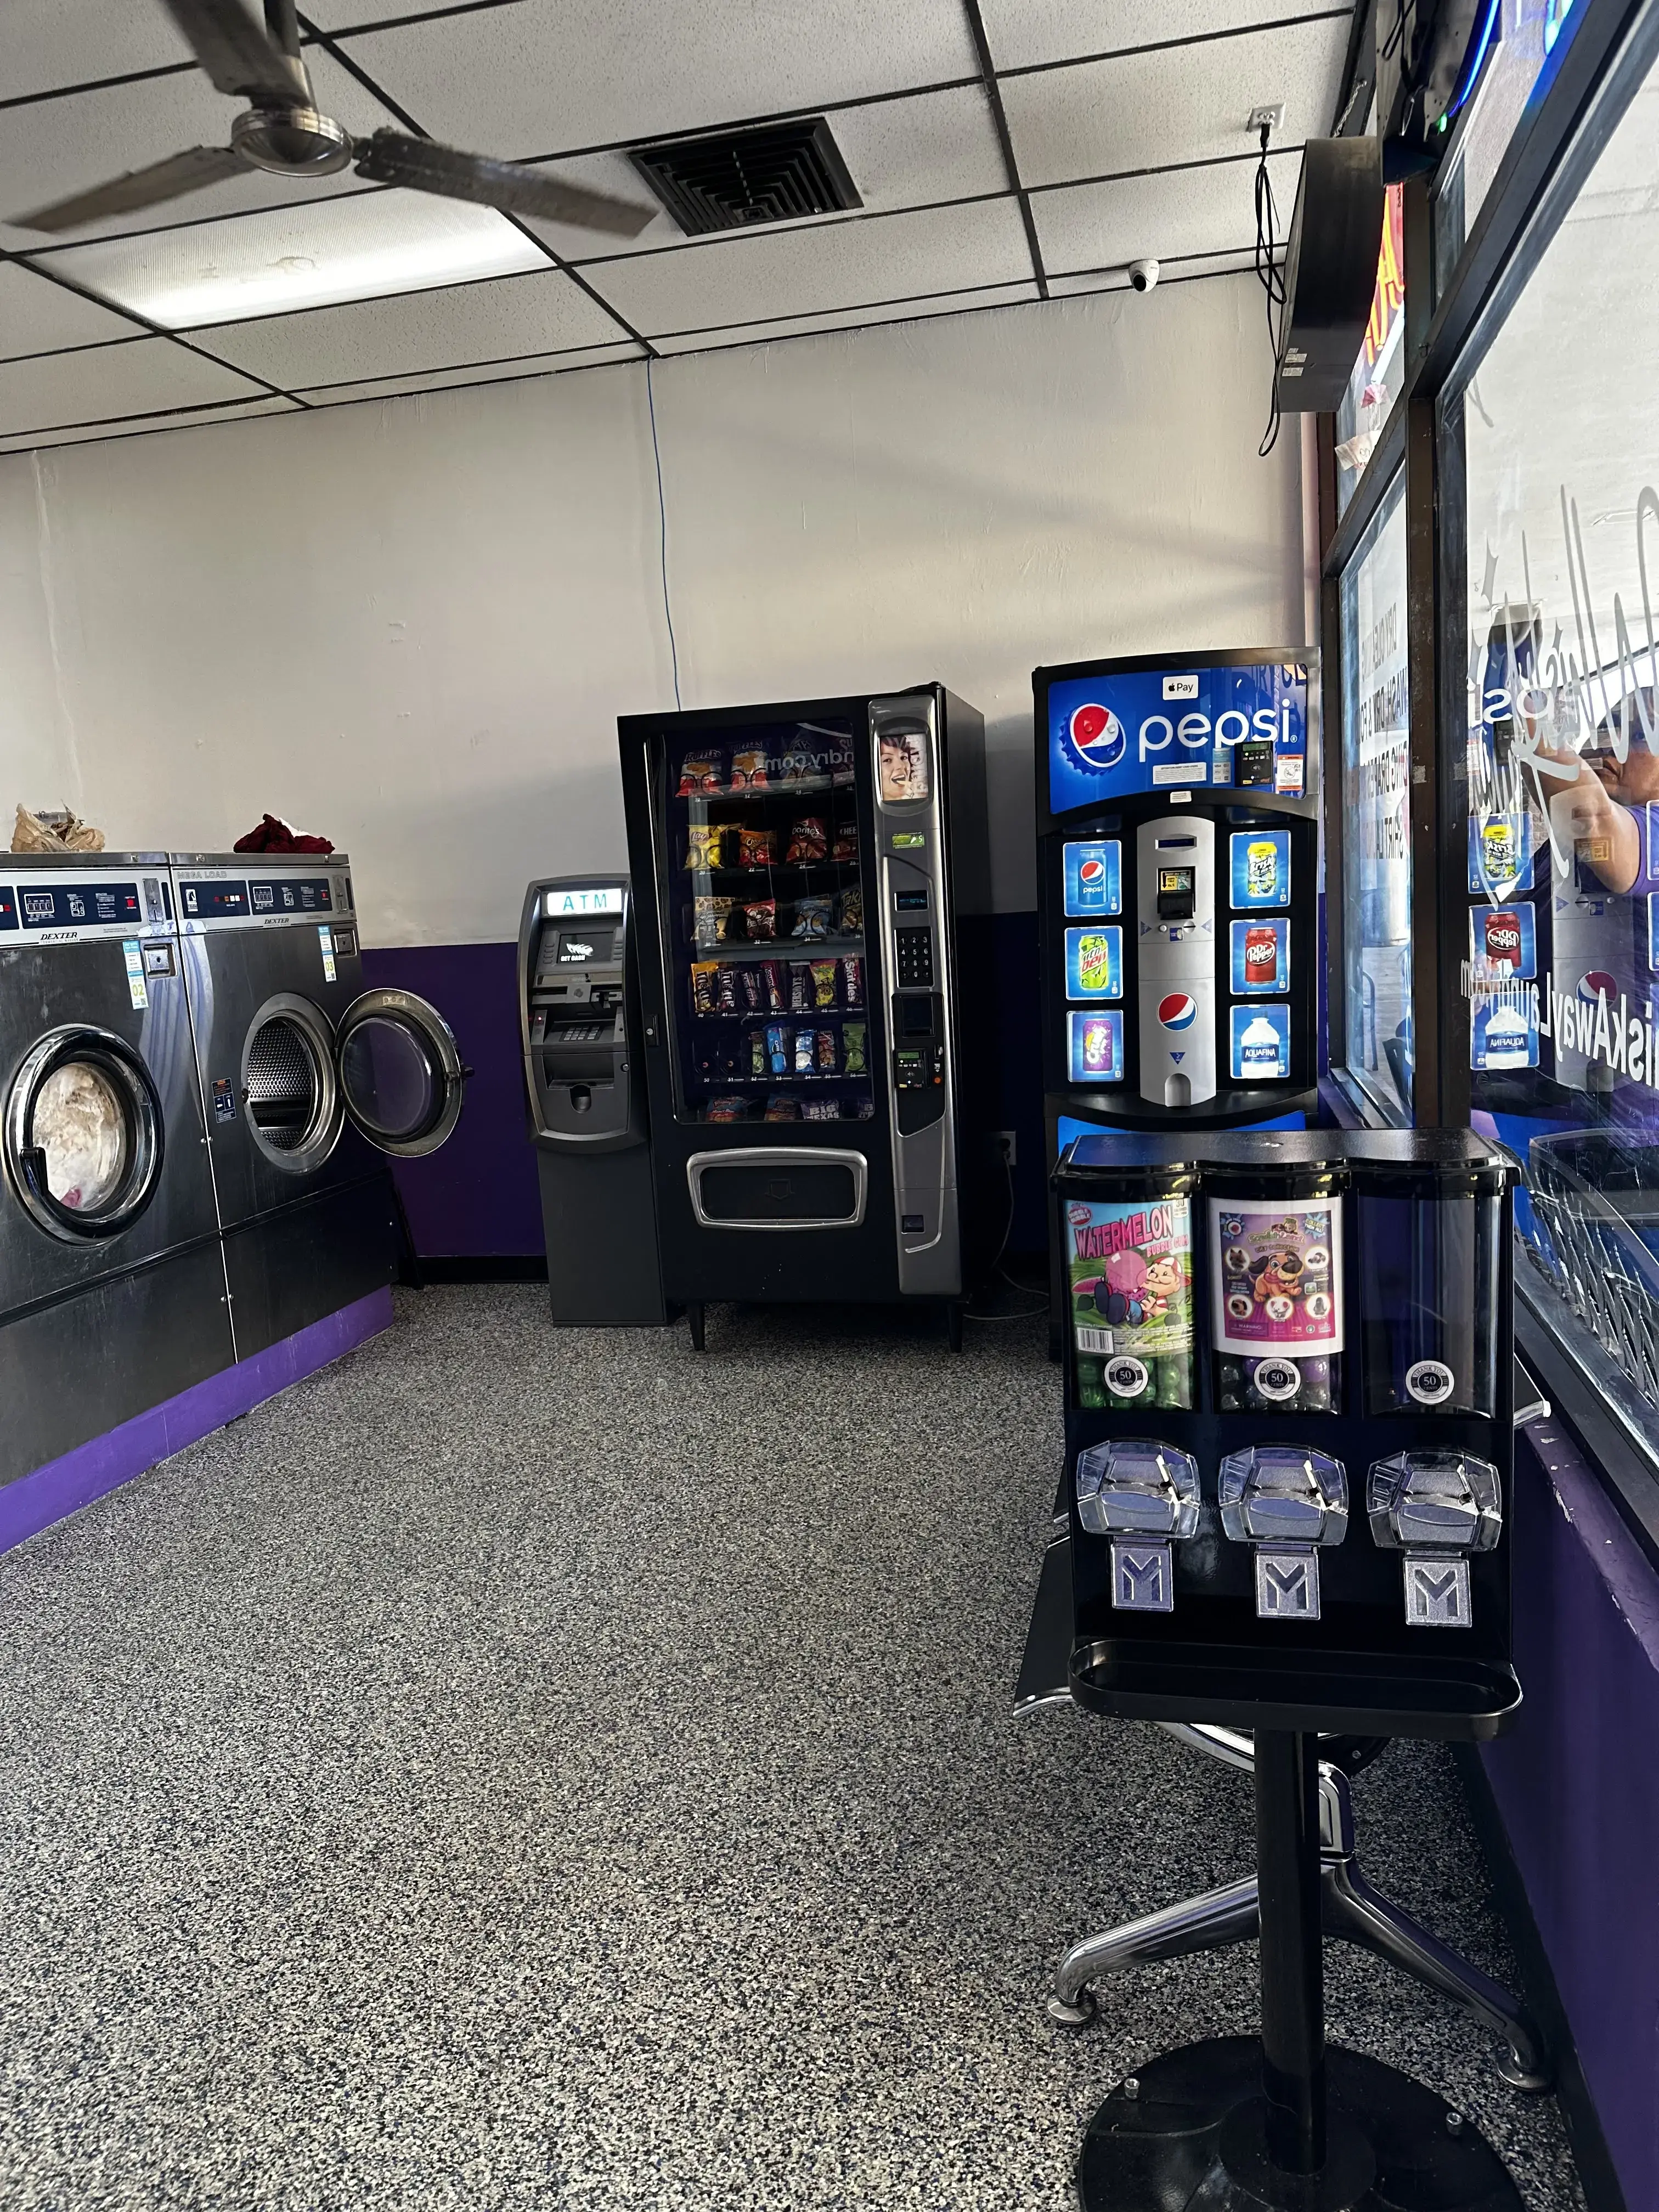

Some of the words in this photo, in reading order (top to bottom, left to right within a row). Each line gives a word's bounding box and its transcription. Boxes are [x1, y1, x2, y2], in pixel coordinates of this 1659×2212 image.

[1177, 682, 1194, 692] Pay
[1139, 698, 1290, 763] pepsi
[1083, 885, 1103, 894] pepsi
[563, 893, 607, 911] ATM
[40, 932, 77, 940] DEXTER
[1256, 944, 1268, 953] Dr
[1249, 946, 1273, 962] Pepper
[325, 961, 334, 972] 03
[132, 984, 144, 996] 02
[1245, 1048, 1276, 1058] AQUAFINA
[809, 1104, 836, 1115] BIG
[1074, 1204, 1173, 1260] WATERMELON
[1146, 1239, 1172, 1257] BUBBLE
[1173, 1234, 1188, 1248] GUM
[1111, 1361, 1127, 1371] THANK
[1262, 1363, 1280, 1373] THANK
[1414, 1366, 1432, 1376] THANK
[1120, 1370, 1131, 1380] 50
[1271, 1373, 1283, 1383] 50
[1424, 1376, 1436, 1385] 50
